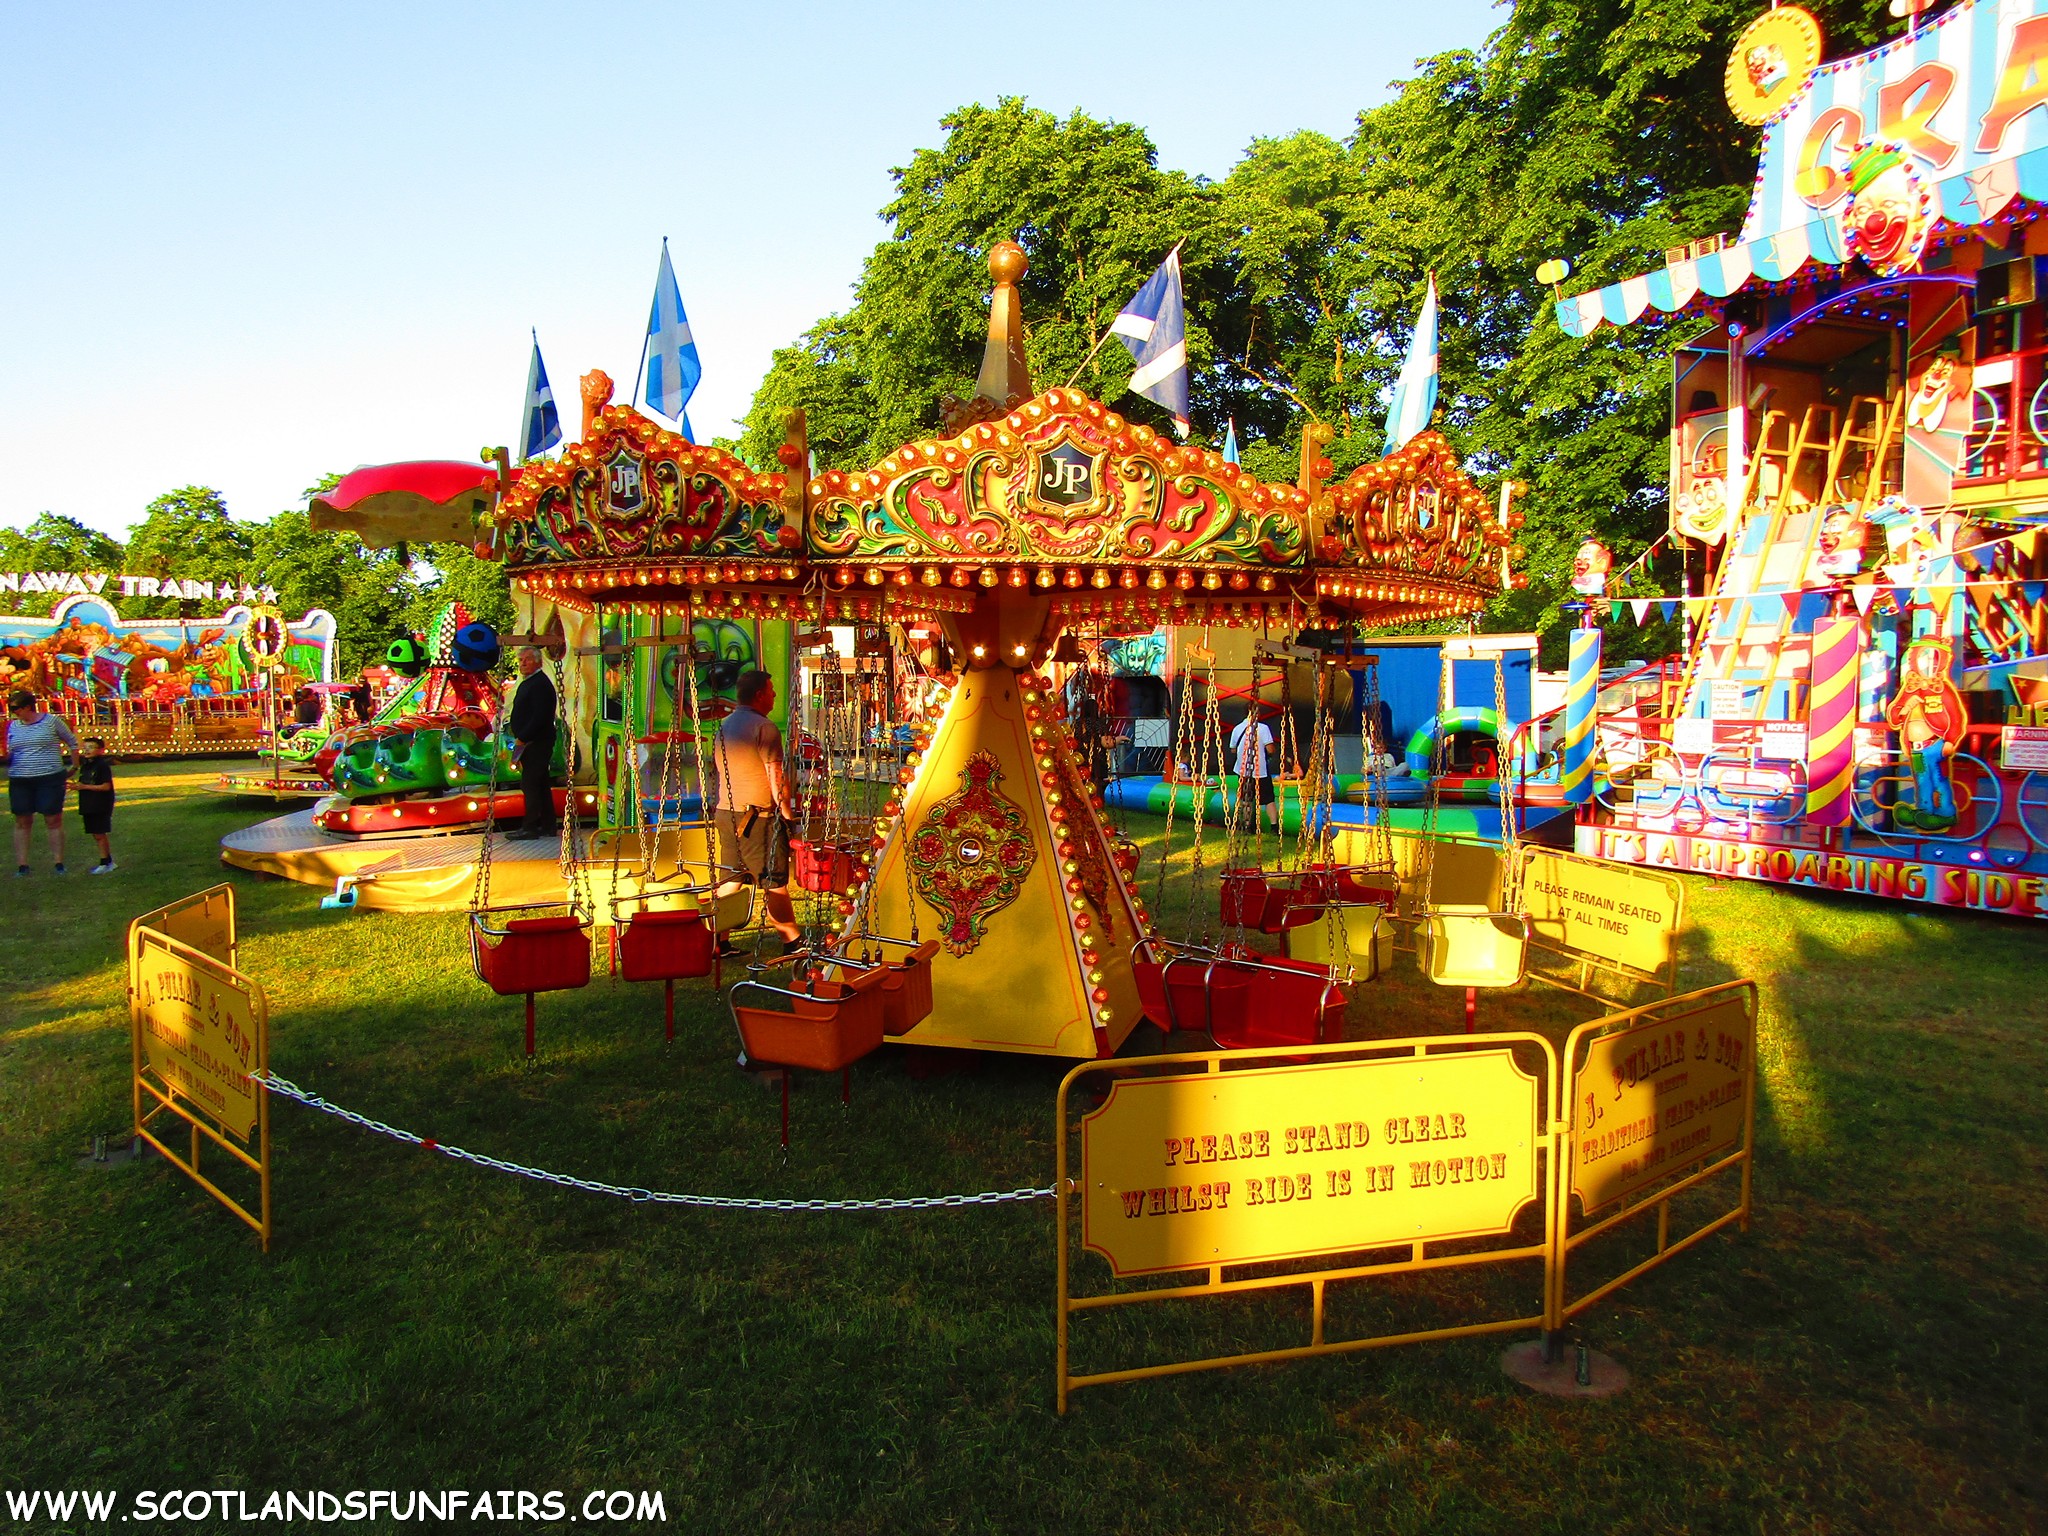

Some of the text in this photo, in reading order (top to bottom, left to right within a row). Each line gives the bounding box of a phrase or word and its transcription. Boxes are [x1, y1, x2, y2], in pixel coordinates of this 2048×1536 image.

[611, 464, 638, 498] JP
[1044, 456, 1088, 495] JP
[119, 575, 214, 600] TRAIN
[1766, 723, 1804, 732] NOTICE
[1594, 829, 2048, 916] IT'S A RIPROARING SIDE
[1534, 880, 1662, 924] PLEASE REMAIN SEATED
[1557, 906, 1629, 936] AT ALL TIMES
[1585, 1027, 1743, 1129] J. PULLAR & SON
[1164, 1112, 1467, 1167] PLEASE STAND CLEAR
[1582, 1112, 1659, 1165] TRADITIONAL
[1120, 1152, 1507, 1219] WHILST RIDE IS IN MOTION
